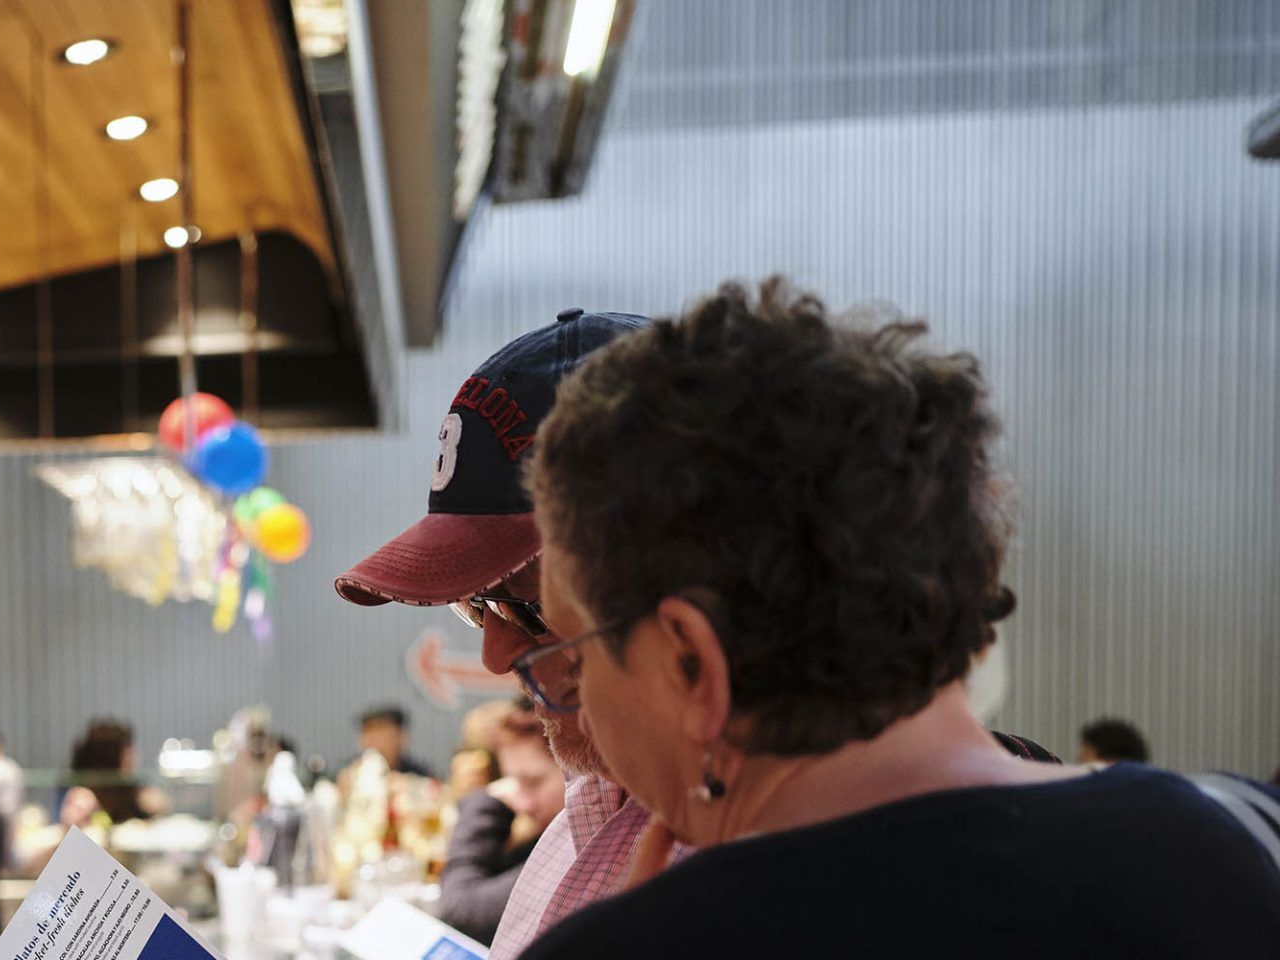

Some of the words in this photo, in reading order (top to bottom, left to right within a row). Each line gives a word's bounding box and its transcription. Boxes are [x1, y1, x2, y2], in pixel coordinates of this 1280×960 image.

[36, 920, 48, 934] de
[49, 871, 80, 918] mercado
[63, 888, 84, 917] dishes
